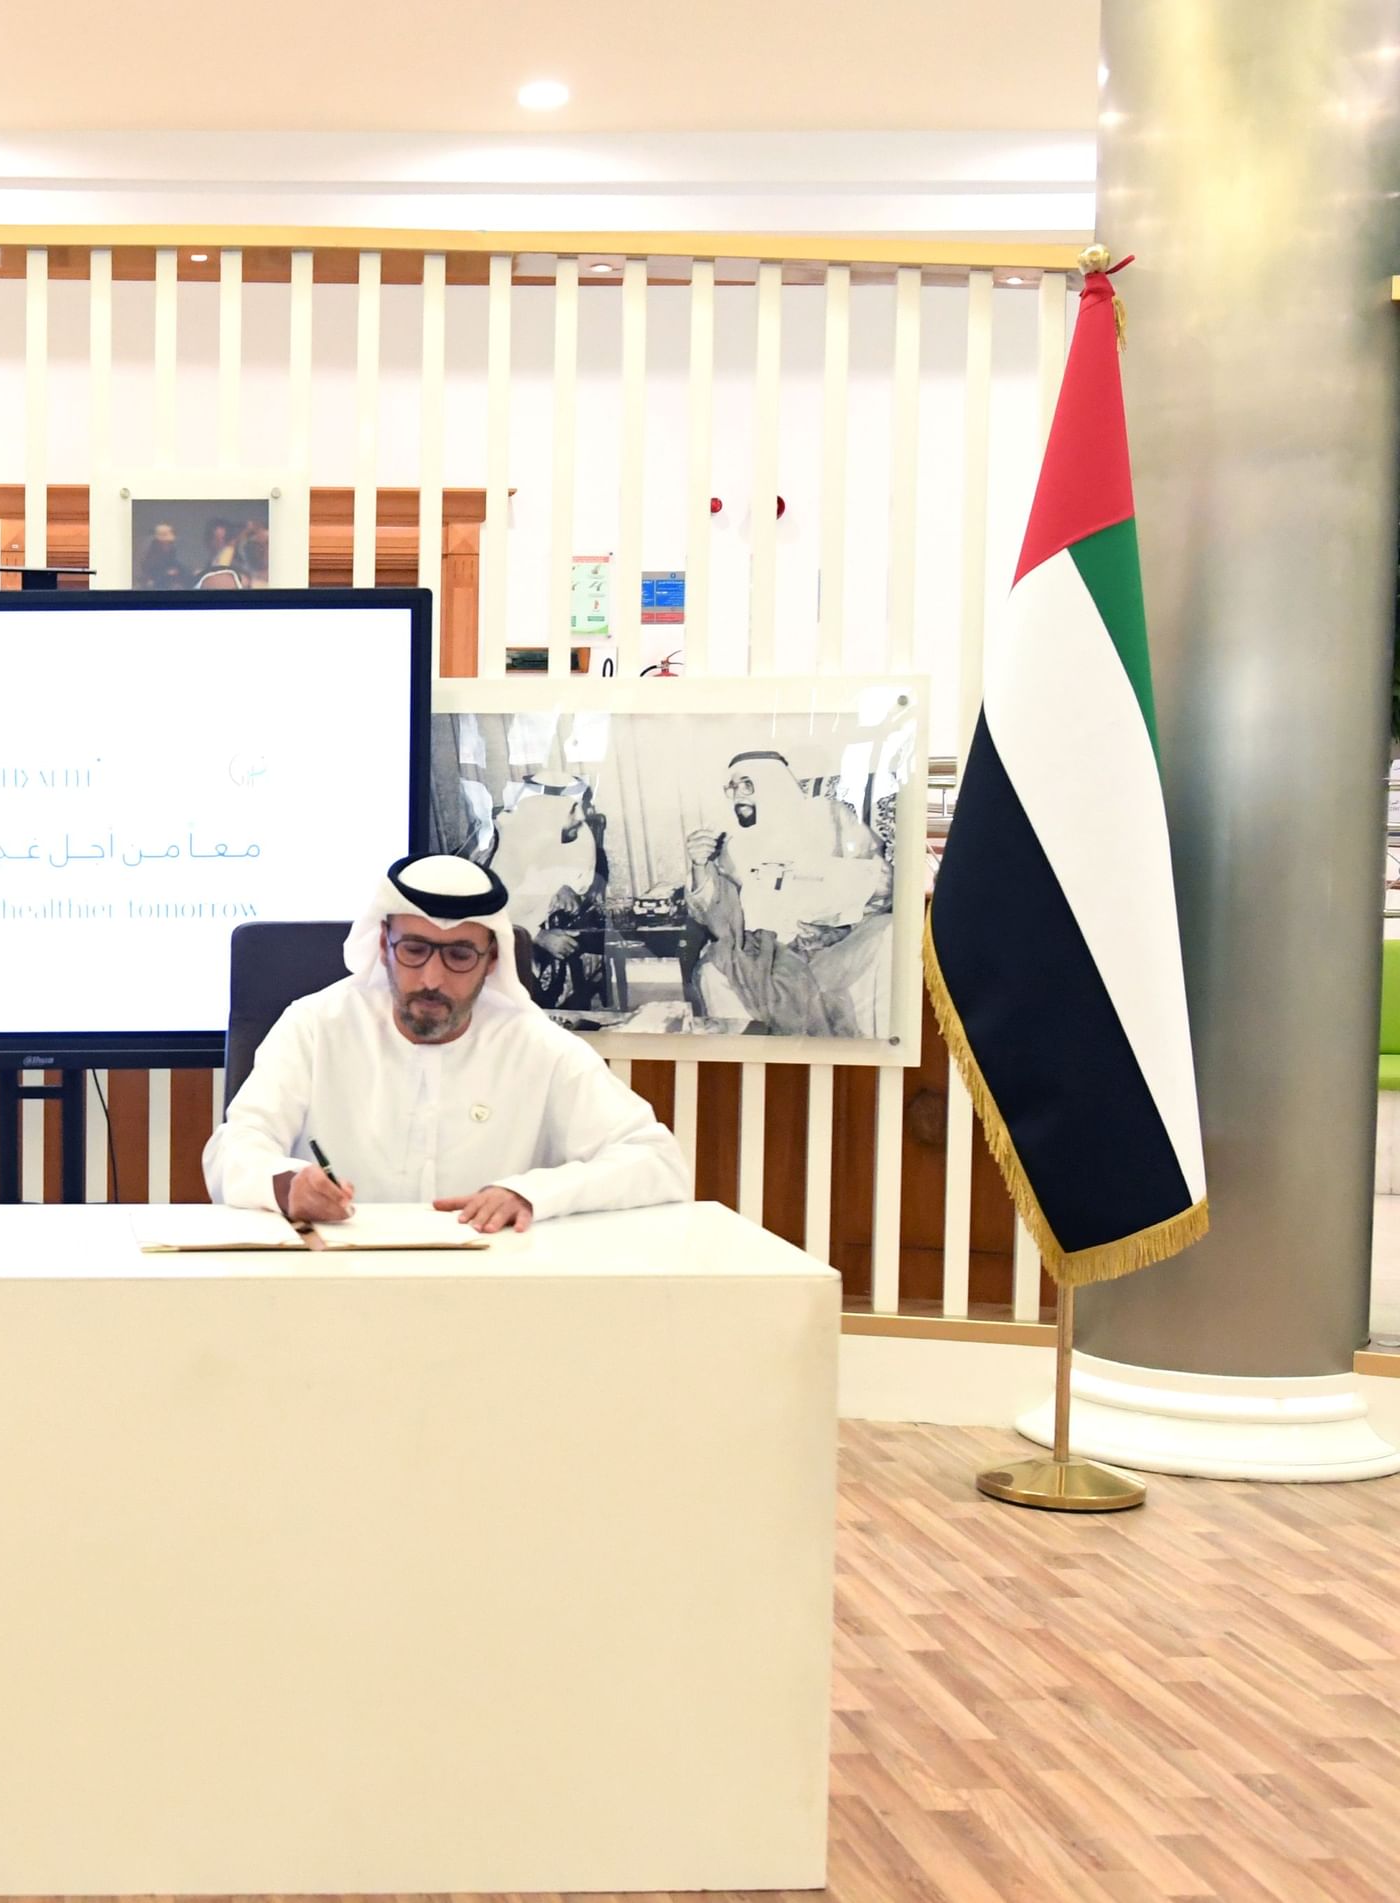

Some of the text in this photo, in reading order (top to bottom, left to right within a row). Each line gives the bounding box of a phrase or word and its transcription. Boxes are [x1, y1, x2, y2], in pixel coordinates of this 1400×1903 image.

[122, 843, 180, 867] من
[1, 898, 113, 920] healthier
[128, 899, 258, 919] tomorrow
